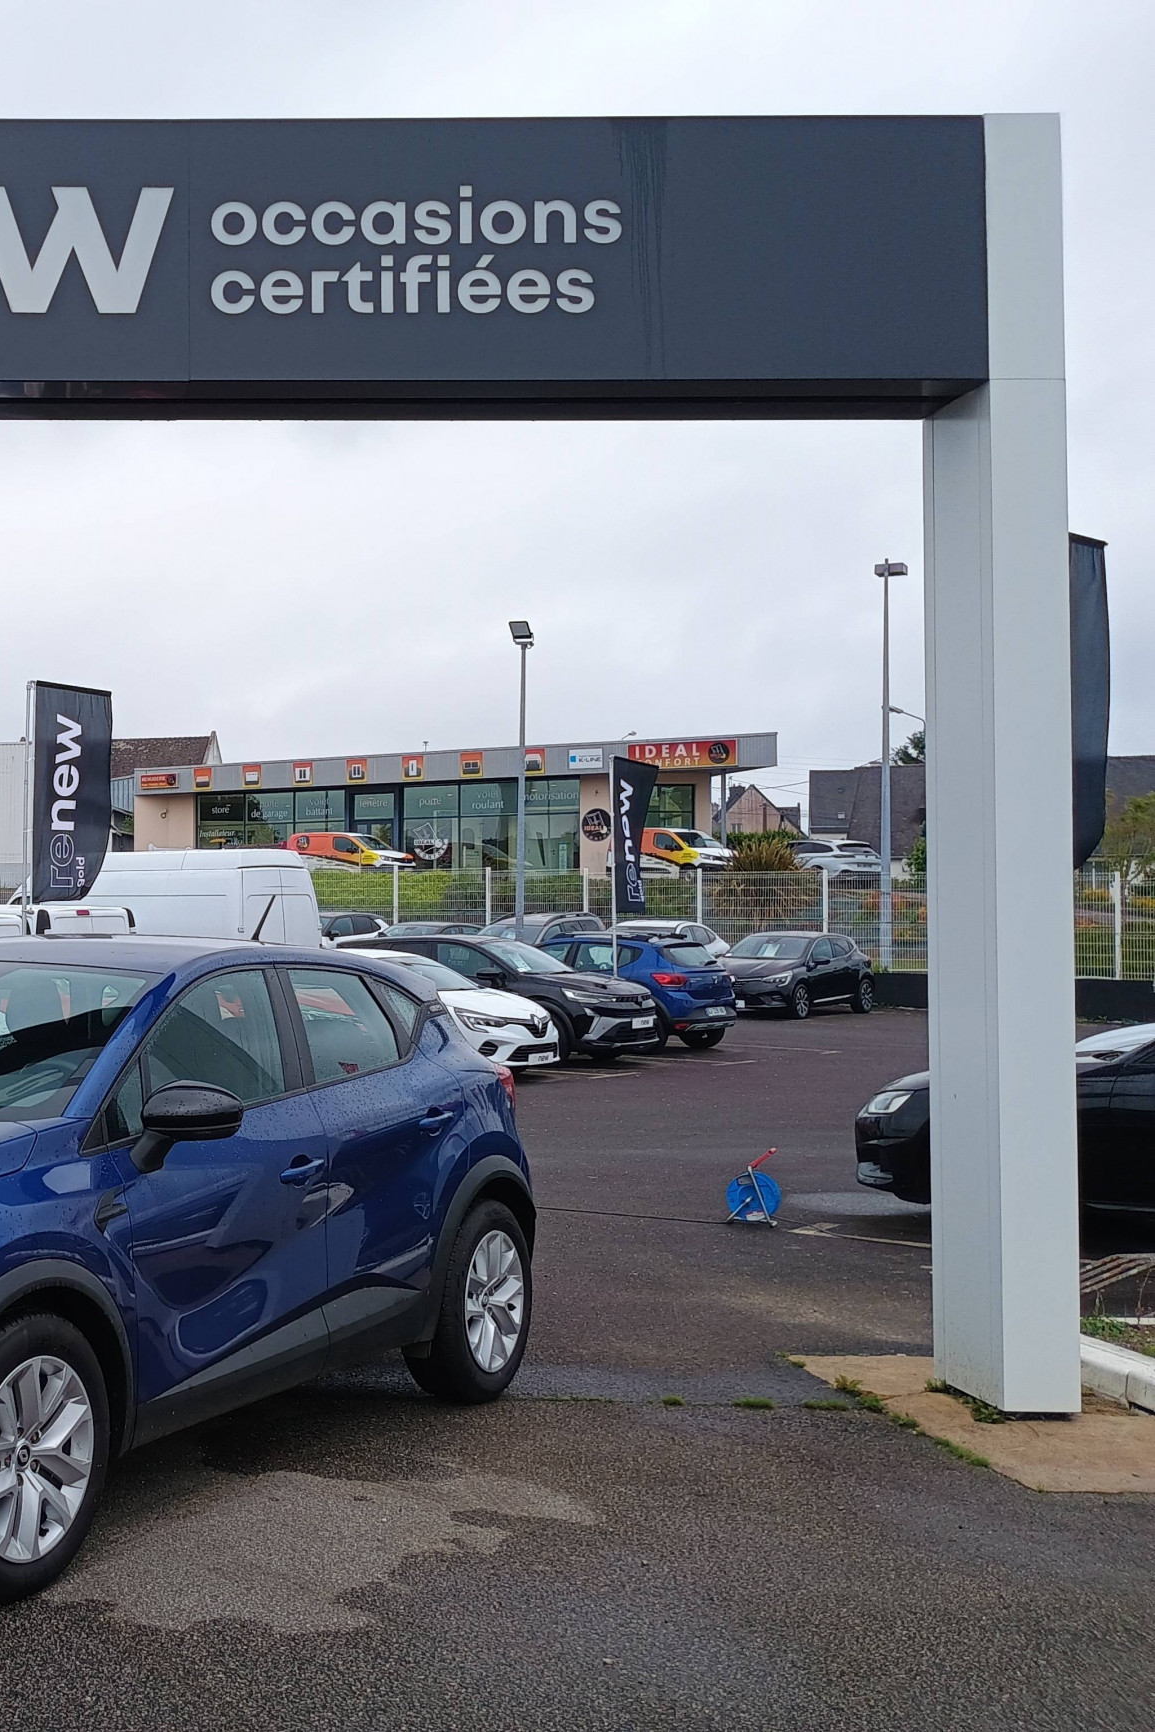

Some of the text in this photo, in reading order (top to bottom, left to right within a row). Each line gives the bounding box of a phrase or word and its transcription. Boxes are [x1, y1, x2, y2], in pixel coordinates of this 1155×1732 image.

[210, 184, 623, 246] occasions
[210, 253, 596, 314] certifiées
[635, 743, 700, 759] IDEAL
[638, 757, 700, 767] ONFORT
[477, 789, 501, 799] volet
[50, 713, 83, 888] renew
[309, 798, 330, 806] volet
[419, 797, 442, 809] porte
[472, 799, 504, 810] roulant
[211, 805, 230, 815] store
[251, 809, 288, 820] de garage
[306, 806, 333, 816] battant
[619, 778, 641, 902] renew
[76, 856, 86, 887] gold
